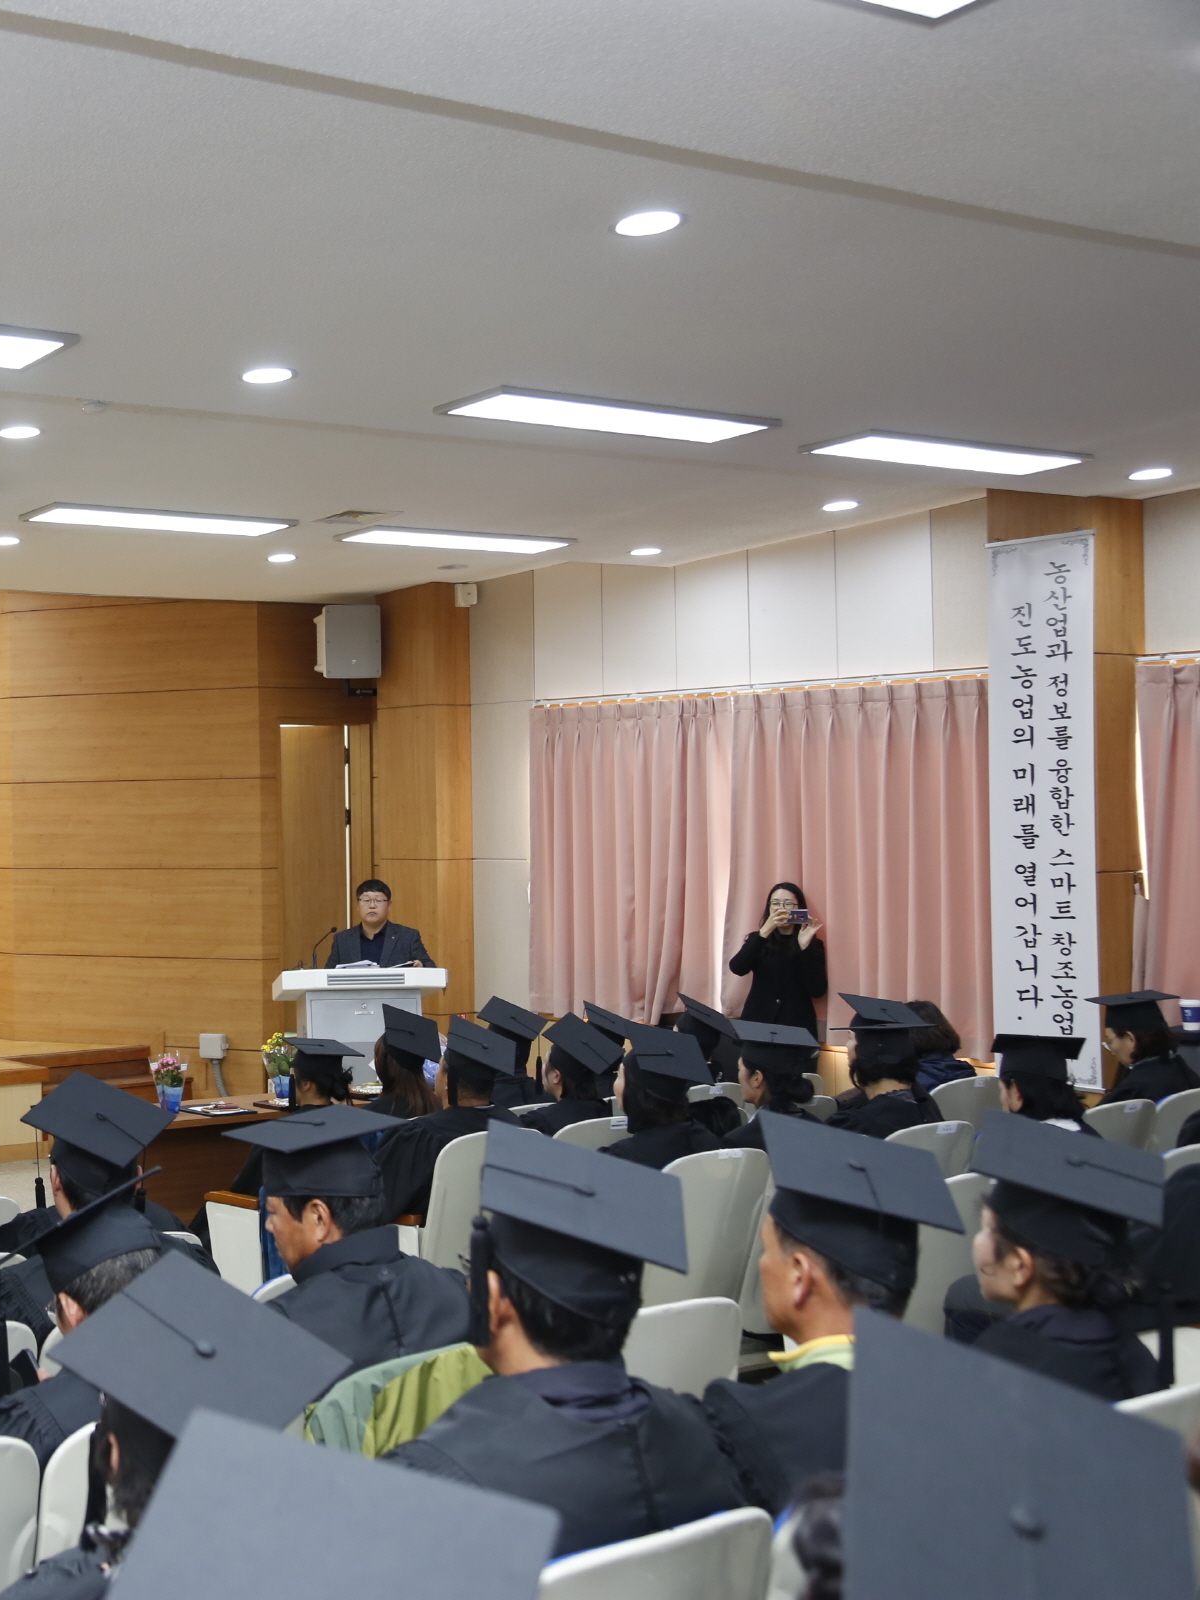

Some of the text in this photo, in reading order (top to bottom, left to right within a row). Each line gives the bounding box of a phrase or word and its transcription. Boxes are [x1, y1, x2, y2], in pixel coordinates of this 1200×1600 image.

[1012, 762, 1040, 850] 미래를
[1044, 561, 1078, 1036] 농산업과 정보를 융합한 스마트 창조농업
